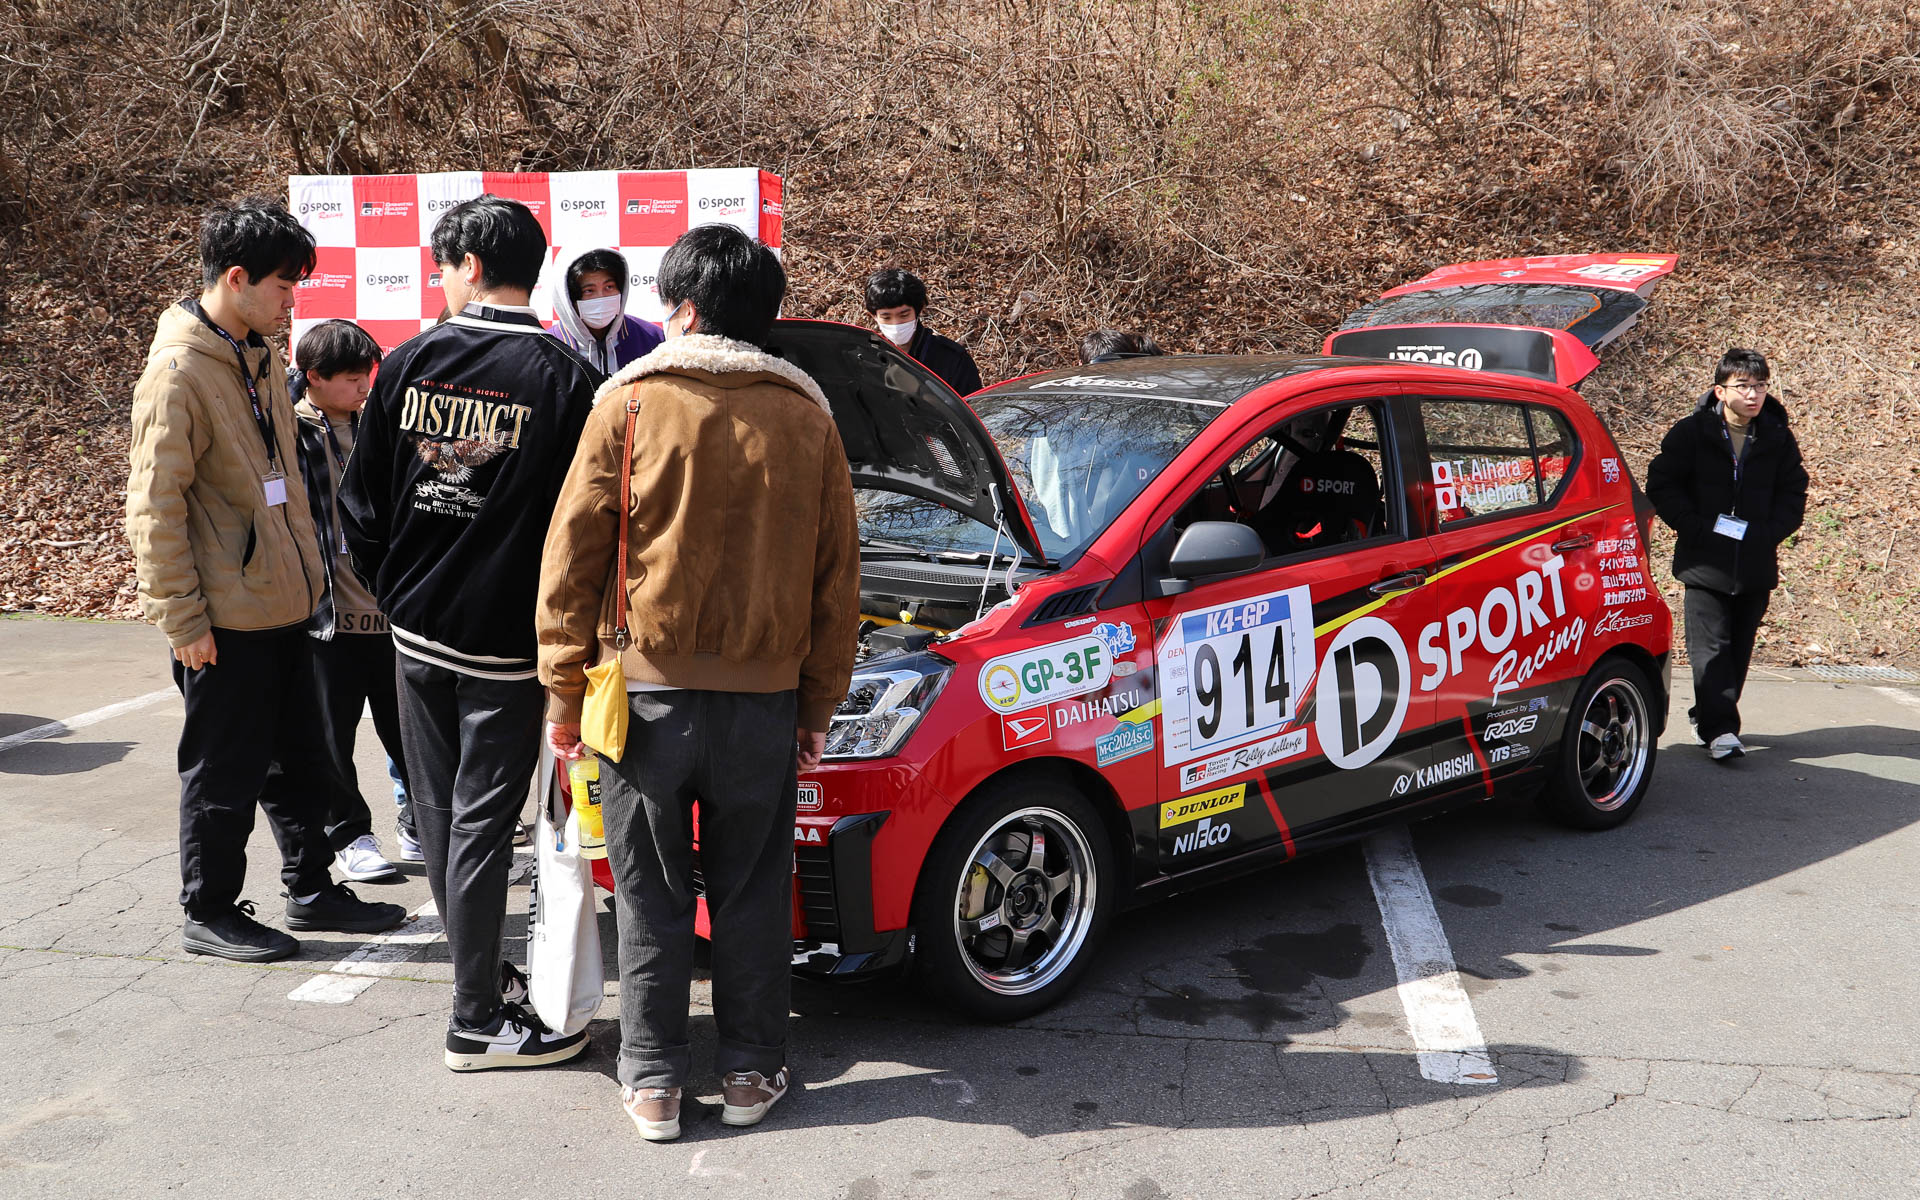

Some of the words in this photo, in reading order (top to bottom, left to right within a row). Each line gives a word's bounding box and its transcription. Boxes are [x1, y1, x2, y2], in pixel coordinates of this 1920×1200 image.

[310, 202, 341, 212] SPORT
[572, 200, 605, 210] SPORT
[626, 205, 650, 214] GR
[711, 198, 745, 207] SPORT
[318, 212, 343, 220] Racing
[361, 207, 383, 216] GR
[580, 210, 607, 218] Racing
[719, 208, 746, 216] Racing
[299, 279, 320, 288] GR
[378, 276, 408, 284] SPORT
[386, 284, 411, 292] Racing
[400, 386, 532, 449] DISTINCT
[1453, 458, 1521, 482] T.Aihara
[1304, 479, 1313, 491] D
[1317, 479, 1355, 495] SPORT
[1460, 482, 1529, 507] A.Uehara
[1602, 572, 1643, 588] 富山ダイハツ
[1205, 601, 1270, 637] K4-GP
[1324, 626, 1406, 764] D
[1417, 554, 1566, 692] SPORT
[1489, 616, 1587, 707] Racing
[1021, 646, 1100, 694] GP-3F
[1195, 625, 1289, 739] 914
[1056, 688, 1140, 728] DAIHATSU
[1487, 706, 1519, 720] Produced
[1483, 714, 1538, 742] RAYS
[1232, 749, 1266, 770] Rally
[1267, 736, 1302, 757] challenge
[1208, 757, 1230, 767] TOYOTA
[1187, 770, 1207, 784] GR
[1207, 768, 1226, 778] Racing
[1416, 753, 1475, 789] KANBISHI
[1176, 792, 1240, 817] DUNLOP
[776, 1071, 786, 1086] N
